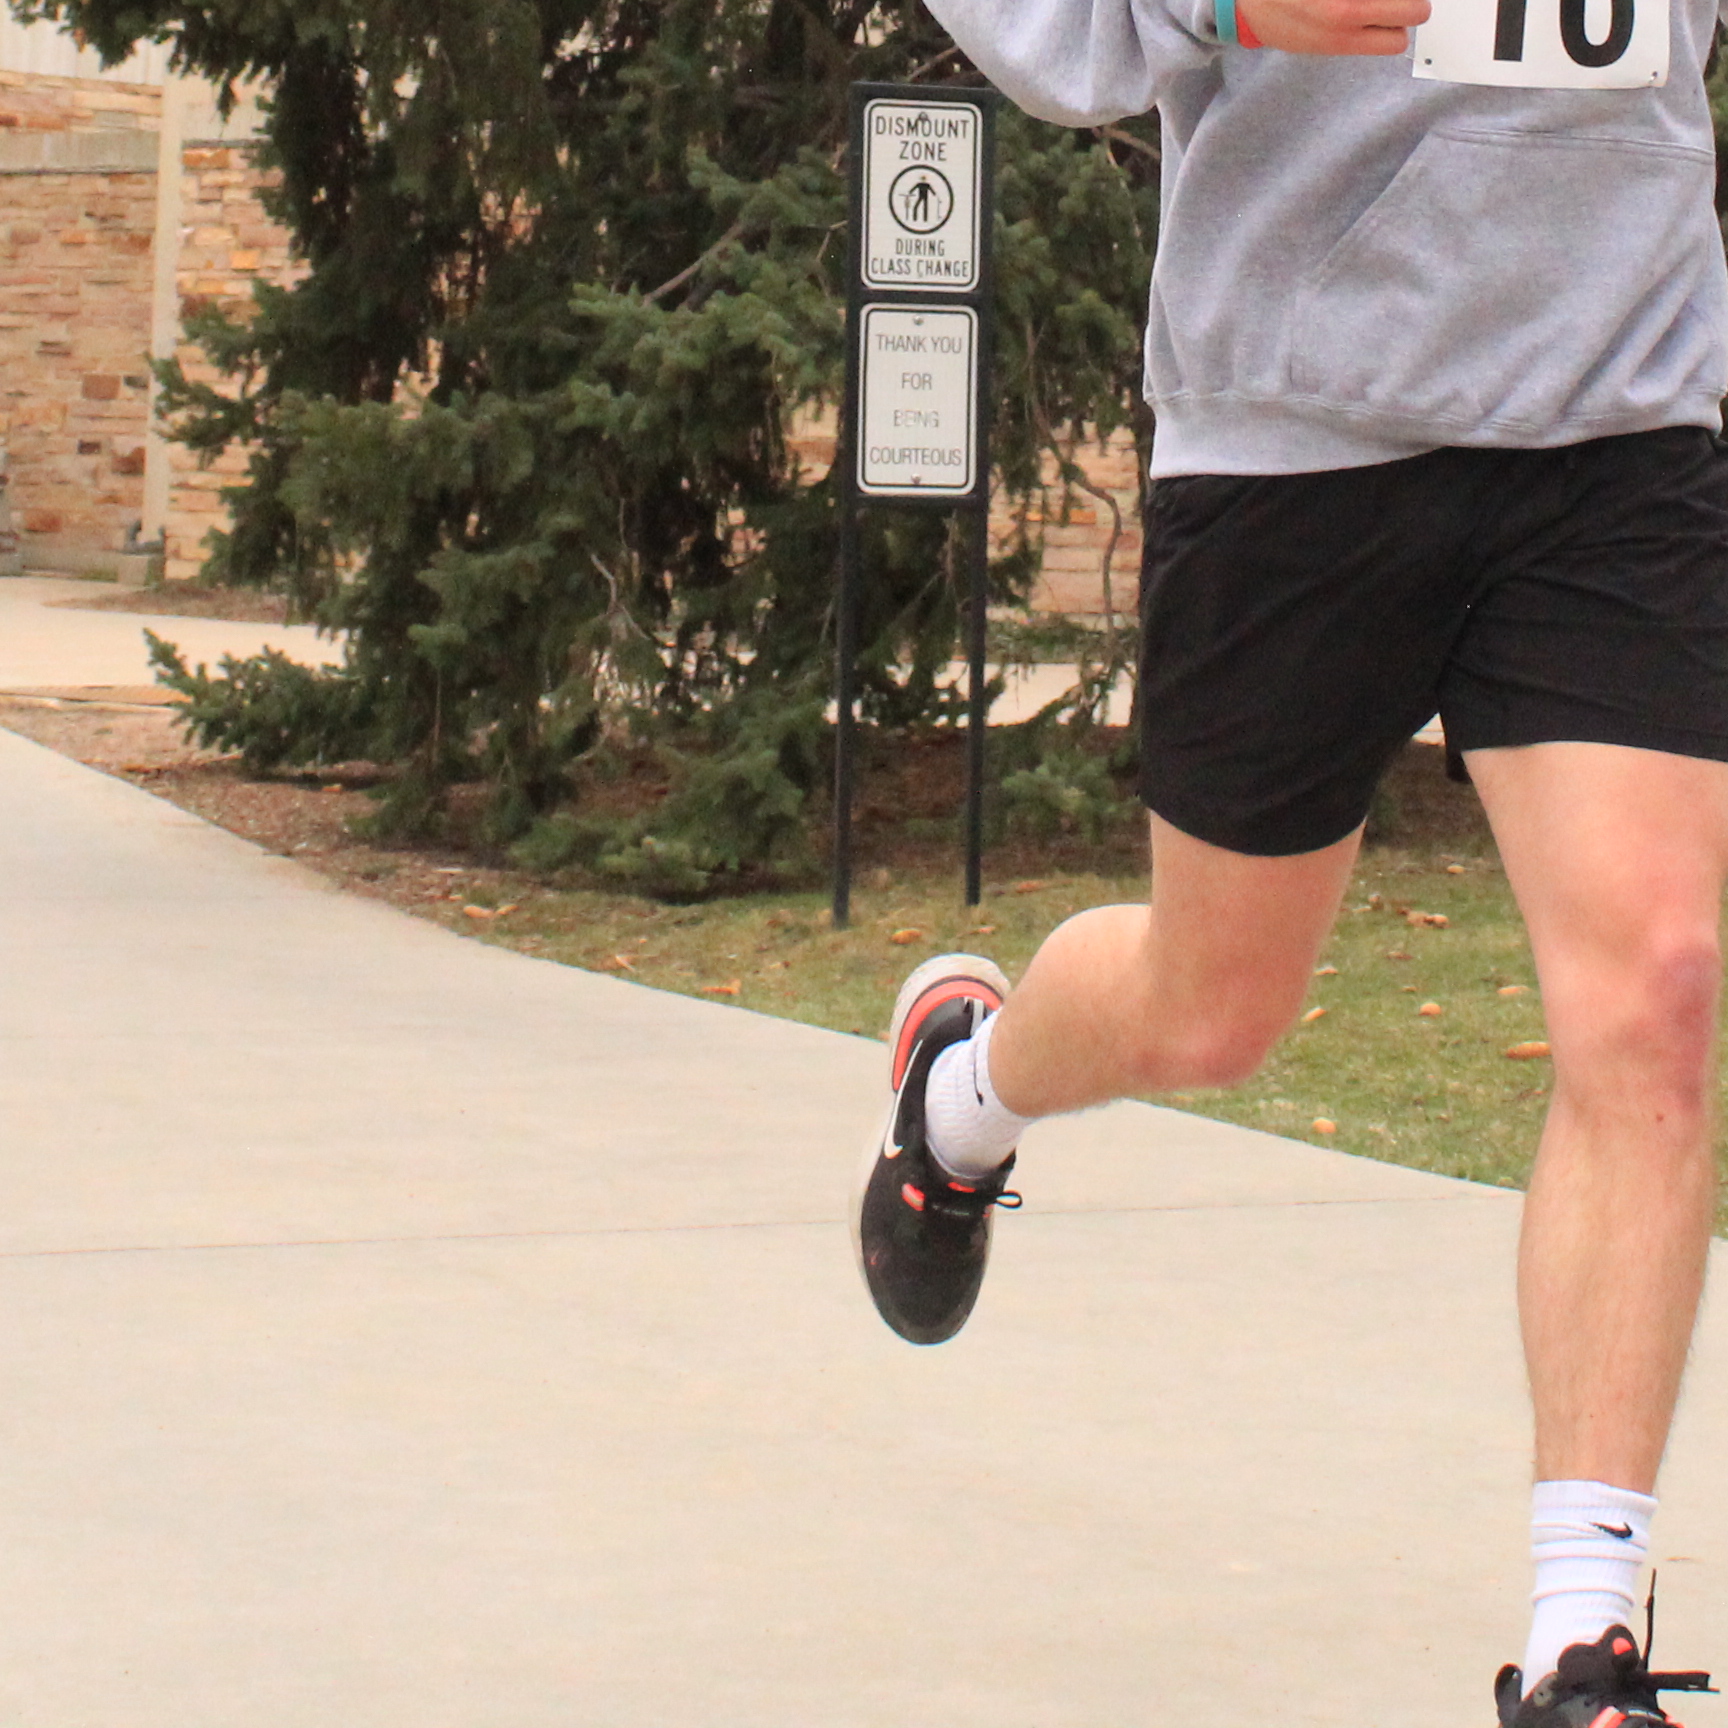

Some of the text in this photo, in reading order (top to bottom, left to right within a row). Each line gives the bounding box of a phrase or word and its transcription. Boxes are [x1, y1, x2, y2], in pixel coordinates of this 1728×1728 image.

[876, 116, 969, 139] DISMOUNT
[899, 141, 947, 162] ZONE
[895, 238, 945, 257] DURING
[871, 257, 969, 278] CLASS CHANGE
[875, 334, 962, 354] THANK YOU
[901, 372, 933, 390] FOR
[870, 446, 962, 467] COURTEOUS
